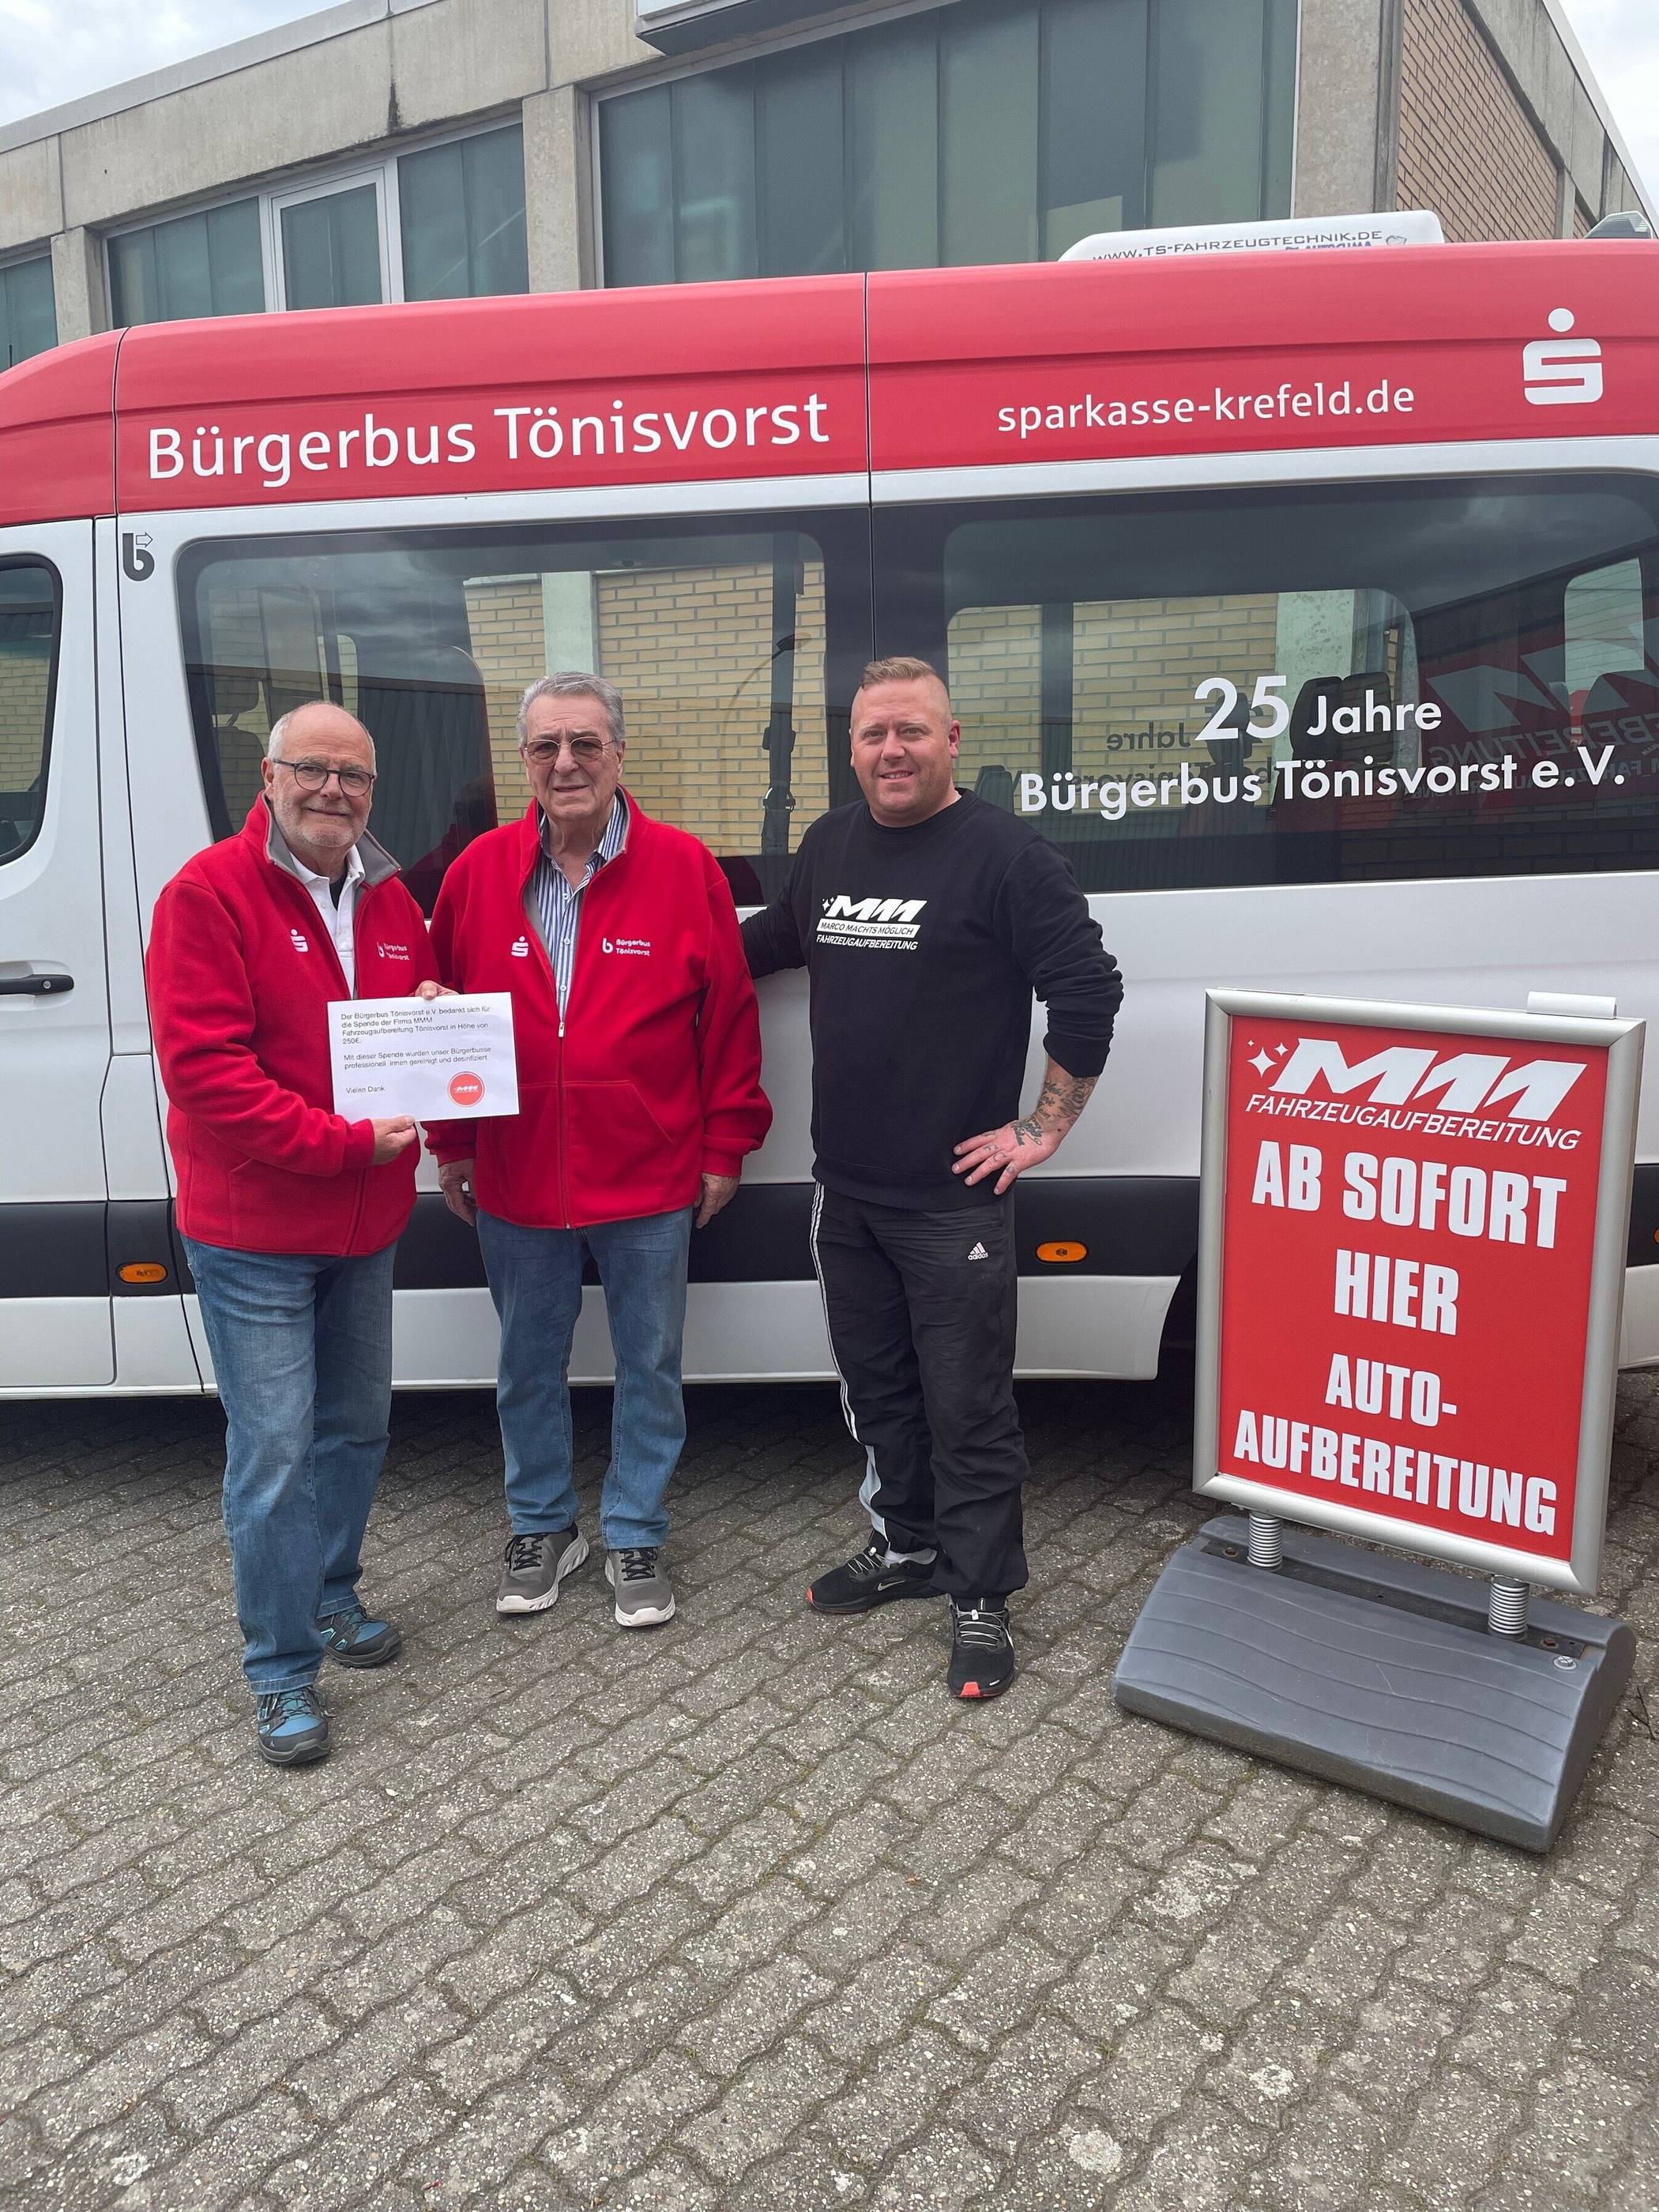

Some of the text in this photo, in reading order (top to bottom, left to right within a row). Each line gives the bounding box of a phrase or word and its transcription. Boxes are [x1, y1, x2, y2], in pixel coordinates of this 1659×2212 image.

[997, 379, 1416, 438] sparkasse-krefeld.de
[148, 393, 830, 487] Bürgerbus Tönisvorst
[1192, 675, 1289, 742] 25
[1306, 689, 1442, 736] Jahre
[1020, 762, 1262, 821] Bürgerbus
[1274, 754, 1518, 800] Tönisvorst
[1531, 744, 1627, 789] e.V.
[616, 939, 651, 947] Bürgerbus
[816, 934, 919, 950] FAHRZEUGAUFBEREITUNG
[820, 922, 914, 935] MARCO MACHTS MÖGLICH
[615, 947, 651, 957] Tönisvorst
[342, 1026, 414, 1036] Fahrzeugaufbereitung
[353, 1020, 379, 1029] Spende
[354, 1011, 389, 1020] Bürgerbus
[344, 1061, 386, 1070] professionell
[409, 1058, 438, 1066] gereinigt
[1245, 1093, 1582, 1150] FAHRZEUGAUFBEREITUNG
[1251, 1140, 1567, 1249] AB SOFORT
[968, 1252, 988, 1261] adidas
[1334, 1248, 1459, 1336] HIER
[1325, 1352, 1458, 1428] AUTO-
[1232, 1409, 1557, 1536] AUFBEREITUNG
